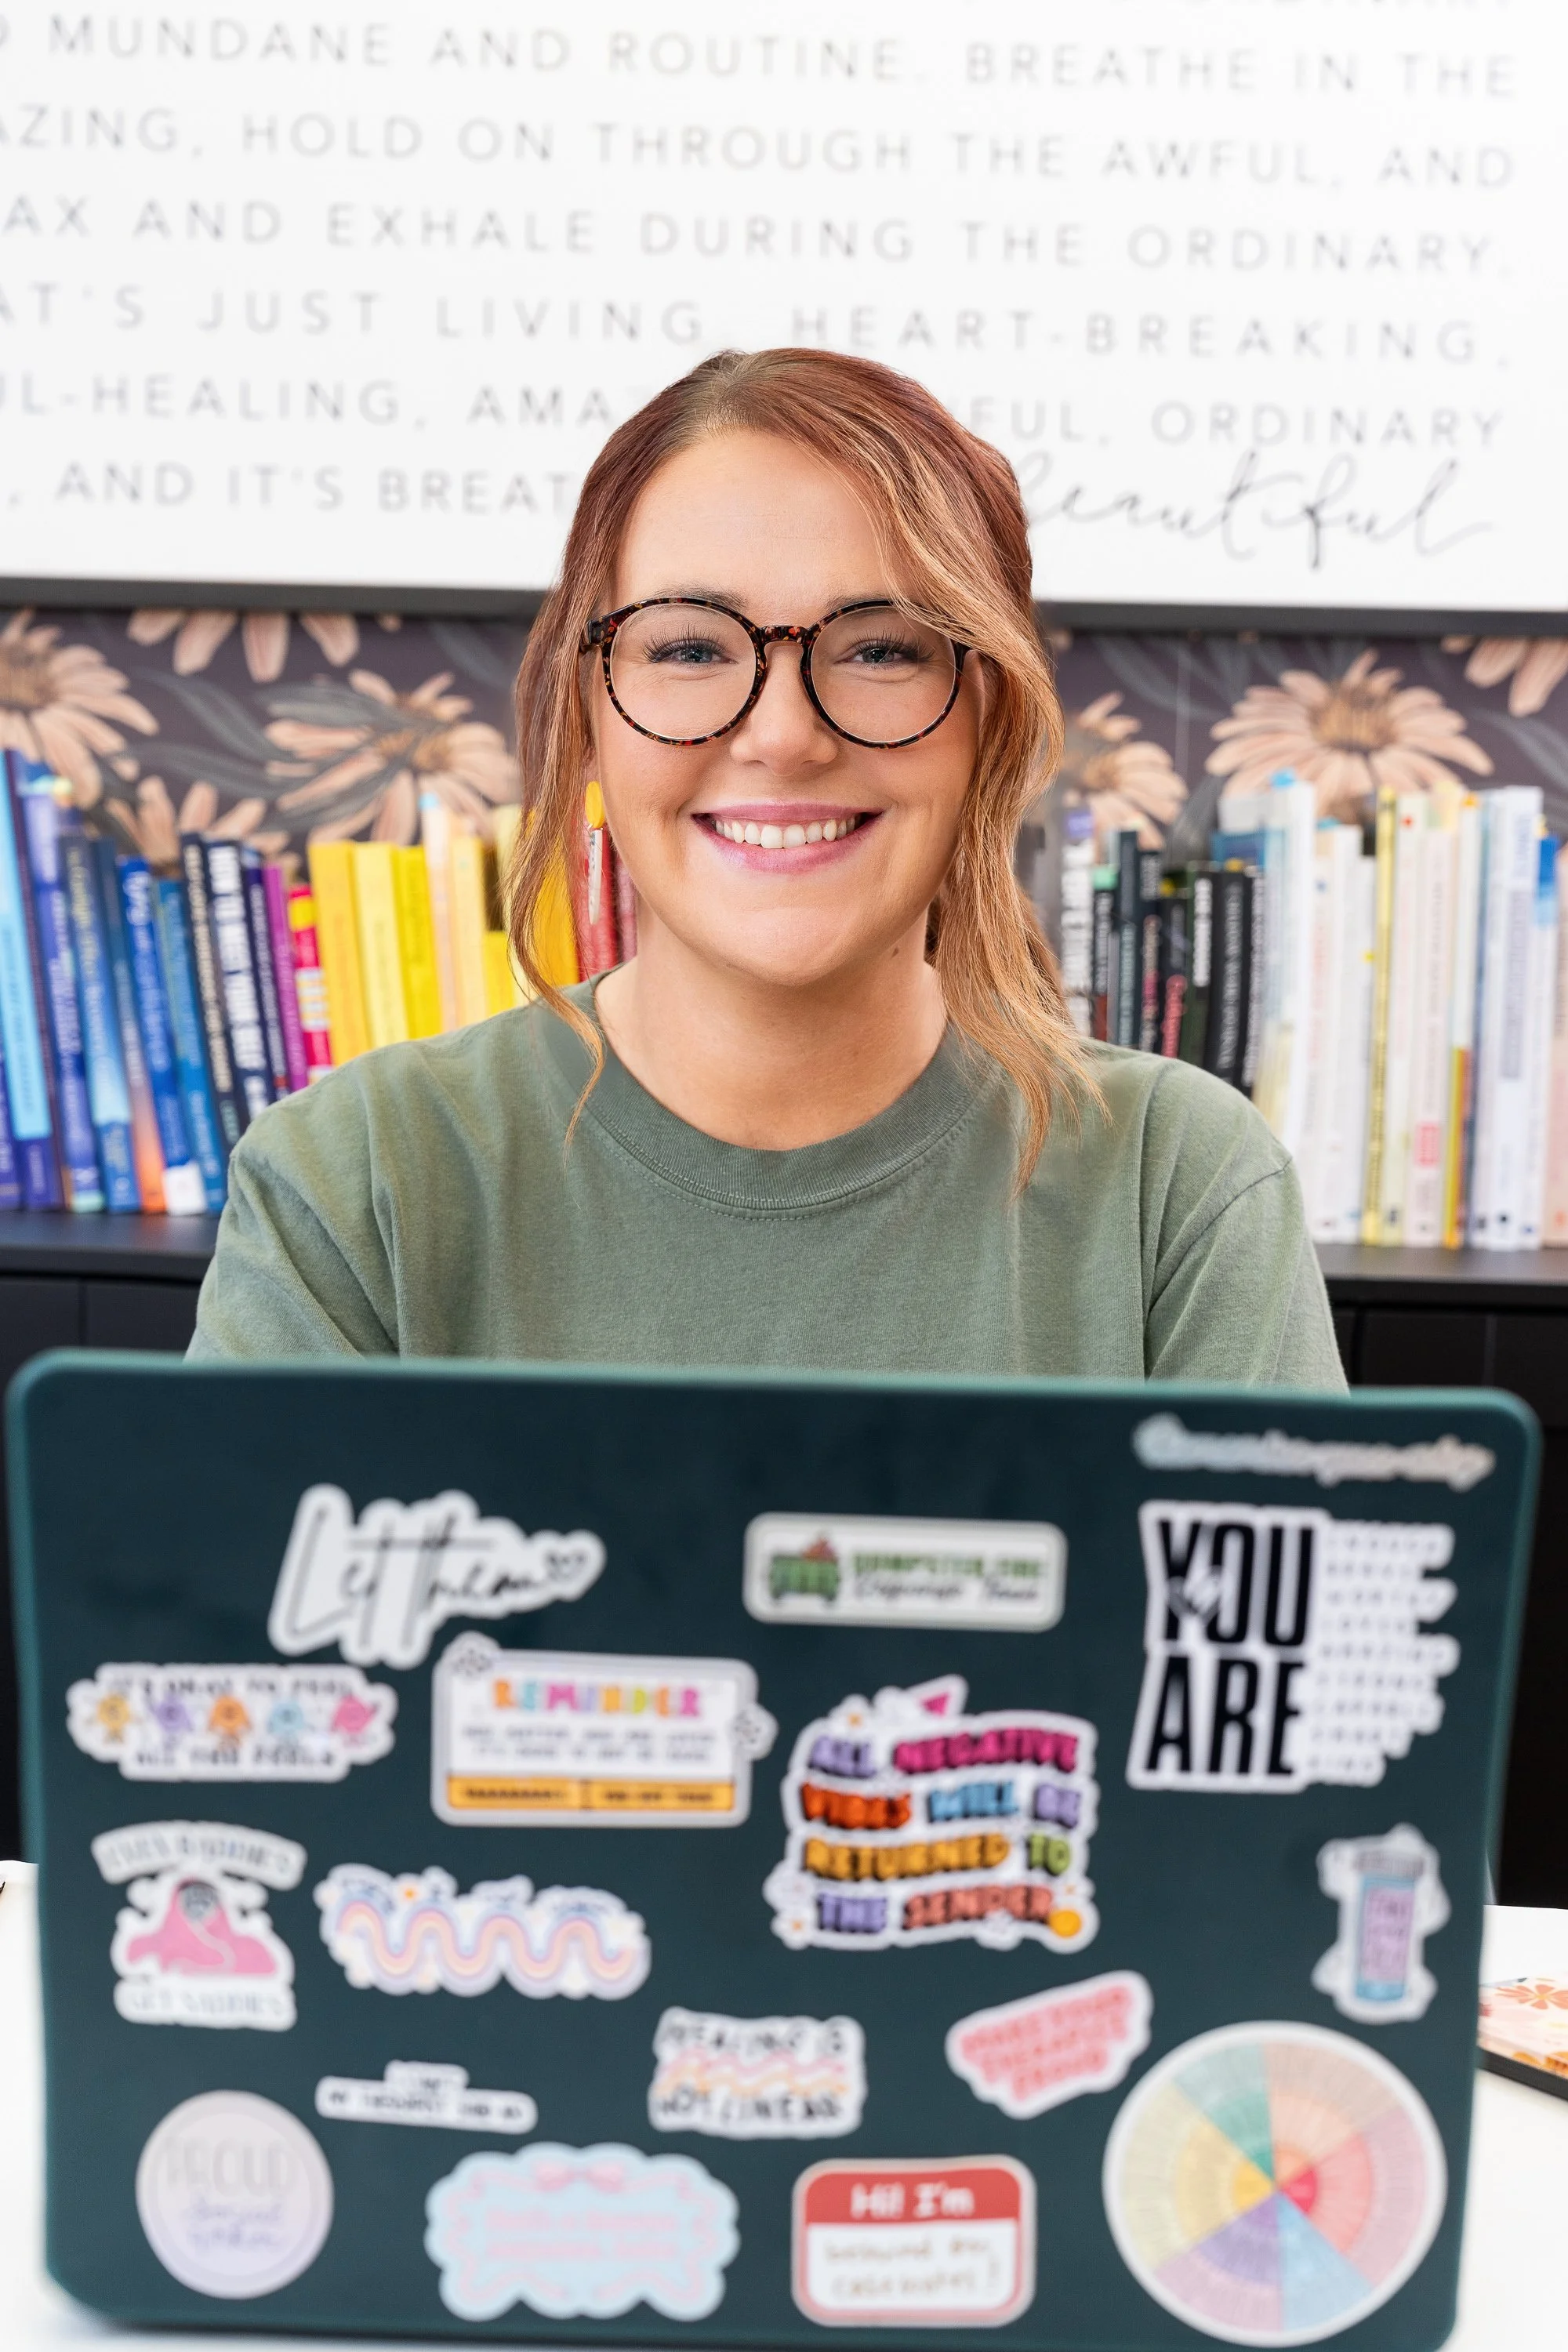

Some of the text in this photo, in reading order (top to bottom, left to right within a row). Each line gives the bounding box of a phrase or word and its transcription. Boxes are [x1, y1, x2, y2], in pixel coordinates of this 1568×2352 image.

[49, 13, 389, 67] MUNDANE
[429, 27, 571, 72] AND
[966, 42, 1253, 92] BREATHE
[1295, 53, 1356, 93] IN
[1400, 53, 1512, 98] THE
[0, 103, 203, 158] ZING,
[242, 112, 423, 160] HOLD
[457, 117, 554, 162] ON
[592, 122, 911, 173] THROUGH
[951, 132, 1064, 178] THE
[1377, 145, 1515, 189] AND
[132, 198, 282, 244] AND
[327, 202, 593, 255] EXHALE
[640, 212, 913, 263] DURING
[960, 220, 1080, 267] THE
[198, 289, 380, 336] JUST
[0, 370, 426, 430] L-HEALING,
[1150, 400, 1504, 448] ORDINARY
[54, 460, 195, 507] AND
[228, 463, 343, 511] IT'S
[1158, 1519, 1314, 1647] YOU
[492, 1678, 701, 1718] REMINDER
[1145, 1656, 1305, 1776] ARE
[894, 1728, 1079, 1774] NEGATIVE
[804, 1832, 1072, 1881] RETURNED TO
[903, 1883, 1054, 1931] SENDER
[162, 2136, 299, 2198] PROUD
[850, 2180, 975, 2220] Hi! I'm
